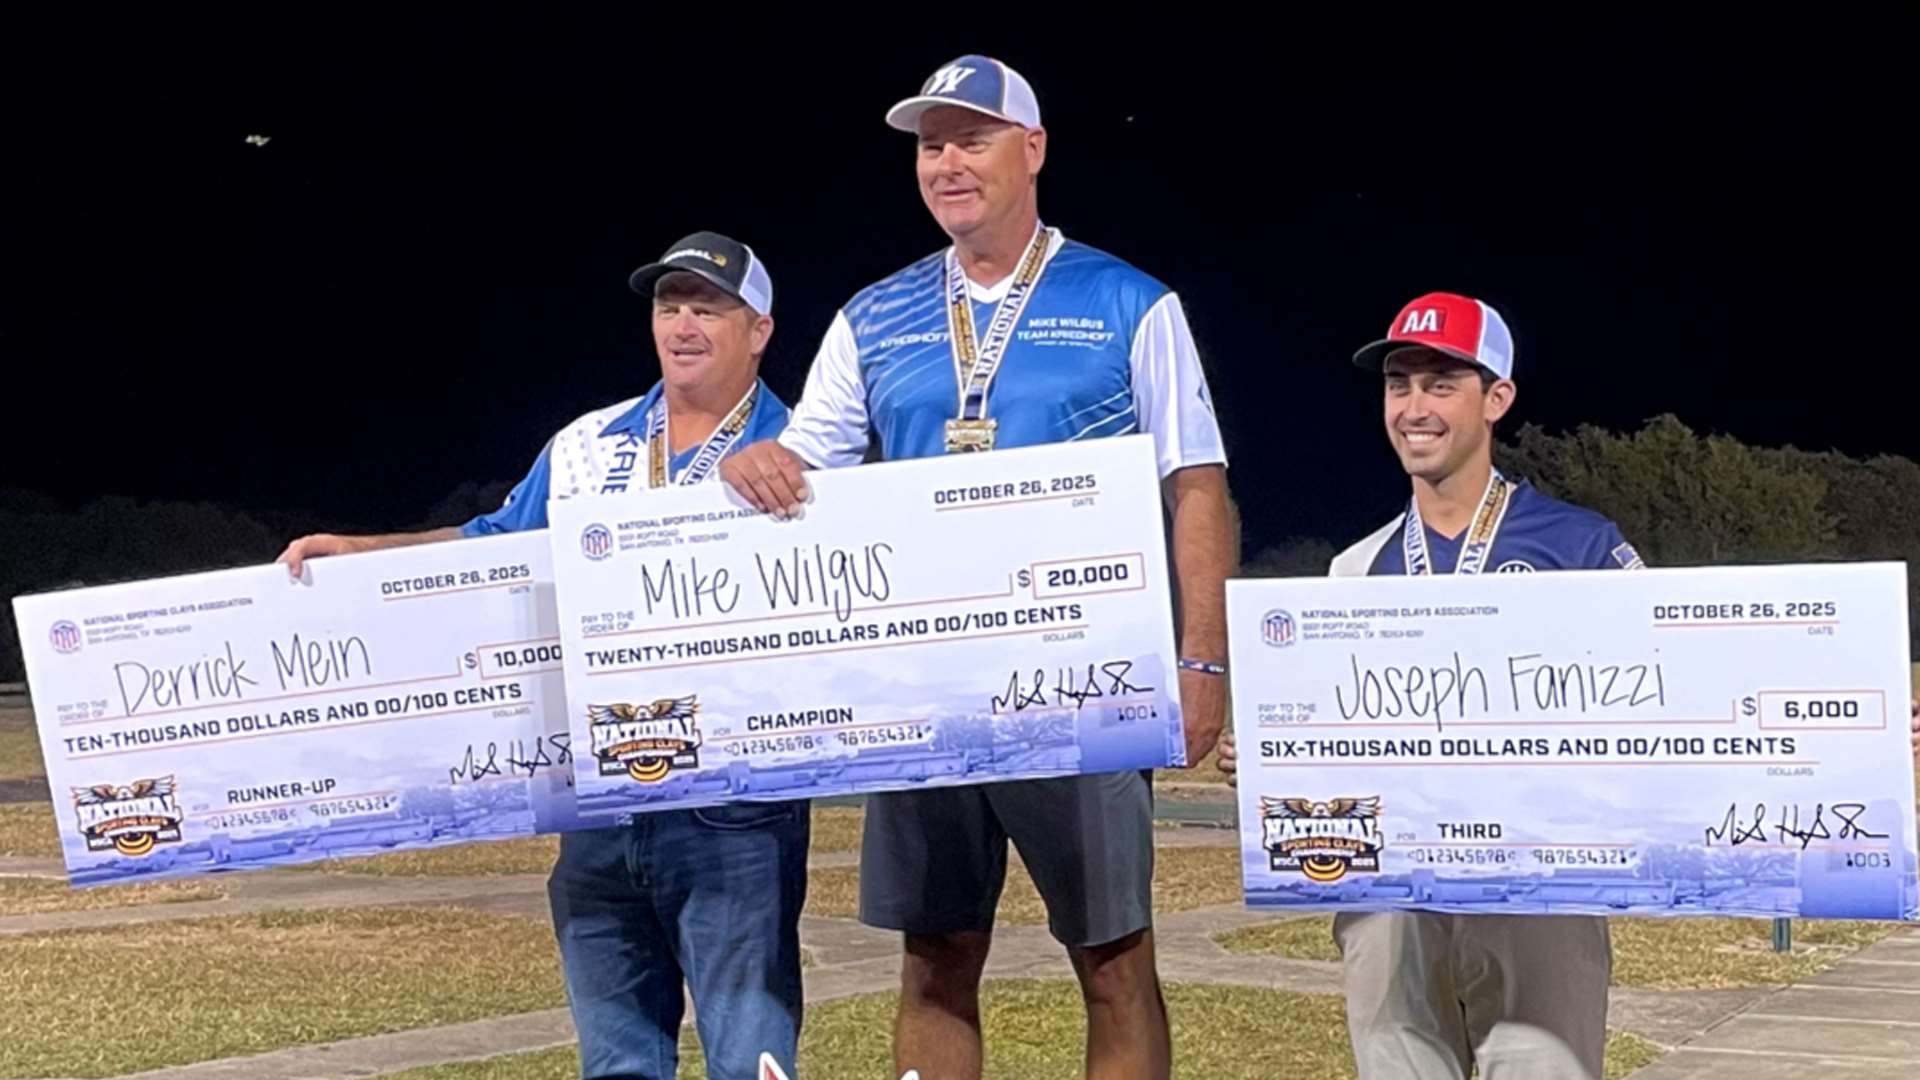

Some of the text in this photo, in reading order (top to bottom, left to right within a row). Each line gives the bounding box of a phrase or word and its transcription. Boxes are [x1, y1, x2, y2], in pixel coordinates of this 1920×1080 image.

[926, 64, 977, 96] W
[973, 283, 1030, 377] NATIONAL
[1028, 317, 1057, 328] MIKE
[1402, 309, 1438, 334] AA
[1017, 330, 1048, 340] TEAM
[933, 474, 1097, 505] OCTOBER 26, 2025
[1071, 497, 1095, 508] DATE
[617, 518, 660, 531] NATIONAL
[707, 510, 735, 522] CLAYS
[381, 564, 531, 596] OCTOBER 26, 2025
[641, 543, 893, 623] Mike Wilgus
[1017, 563, 1129, 589] $ 20,000
[83, 613, 125, 626] NATIONAL
[600, 613, 615, 623] TO
[616, 611, 635, 621] THE
[1301, 606, 1499, 619] NATIONAL SPORTING CLAYS ASSOCIATION
[1653, 602, 1837, 620] OCTOBER 26, 2025
[582, 623, 615, 634] ORDER
[584, 604, 1082, 667] TWENTY-THOUSAND DOLLARS AND 00/100 CENTS
[1042, 630, 1086, 643] DOLLARS
[1807, 626, 1834, 636] DATE
[464, 644, 562, 670] $ 10,000
[113, 630, 371, 717] Derrick Mein
[1336, 648, 1664, 732] Joseph Fanizzi
[63, 683, 523, 753] TEN-THOUSAND DOLLARS AND 00/100 CENTS
[747, 707, 854, 732] CHAMPION
[1258, 703, 1317, 713] PAY TO THE
[1258, 713, 1311, 724] ORDER OF
[1742, 696, 1859, 721] $ 6,000
[1260, 736, 1796, 758] SIX-THOUSAND DOLLARS AND 00/100 CENTS
[1766, 766, 1815, 777] DOLLARS
[227, 778, 337, 804] RUNNER-UP
[1263, 816, 1383, 850] NATIONAL
[1396, 823, 1502, 841] FOR THIRD
